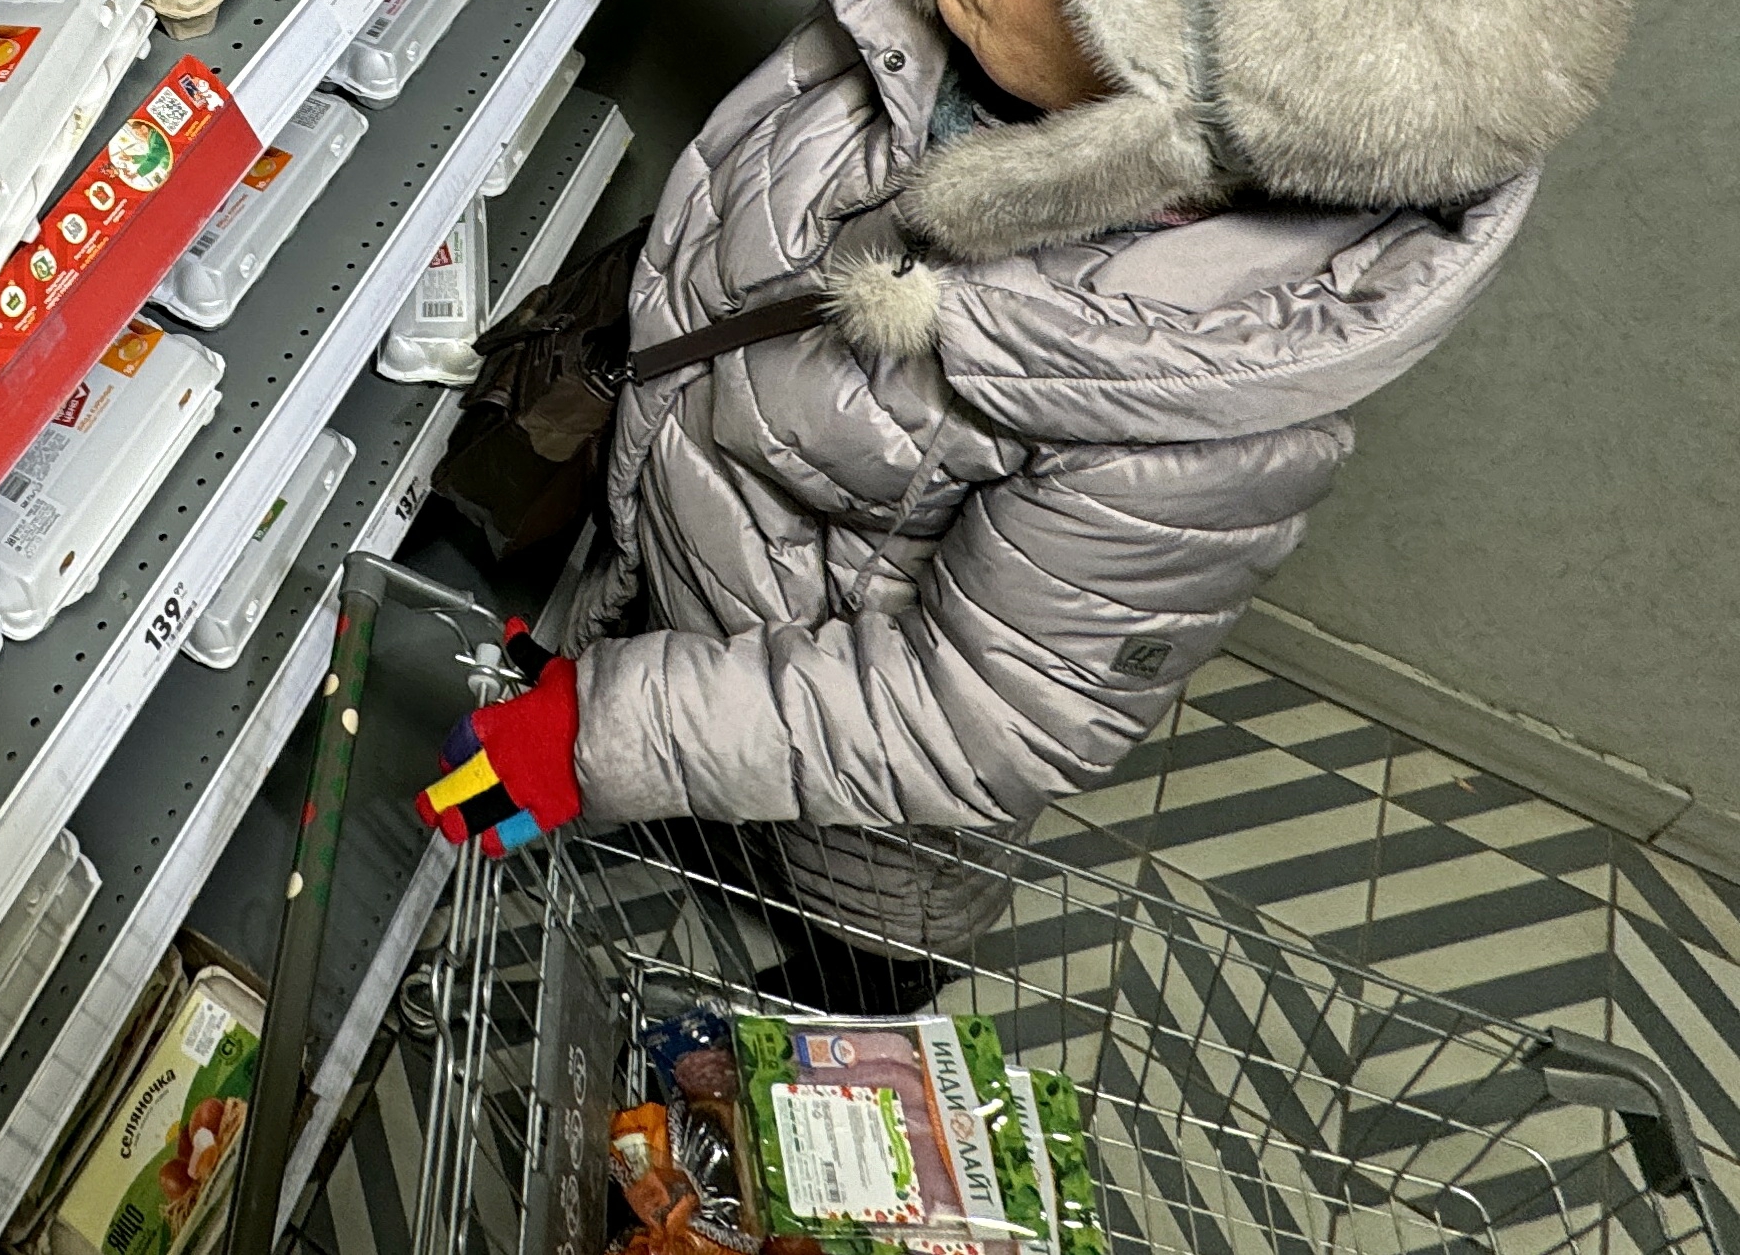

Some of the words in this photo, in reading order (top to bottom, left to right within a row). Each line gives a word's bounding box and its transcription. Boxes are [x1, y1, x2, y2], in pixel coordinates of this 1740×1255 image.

[145, 597, 181, 651] 139
[120, 1068, 176, 1160] селяночка
[107, 1203, 145, 1255] ЯЙЦО
